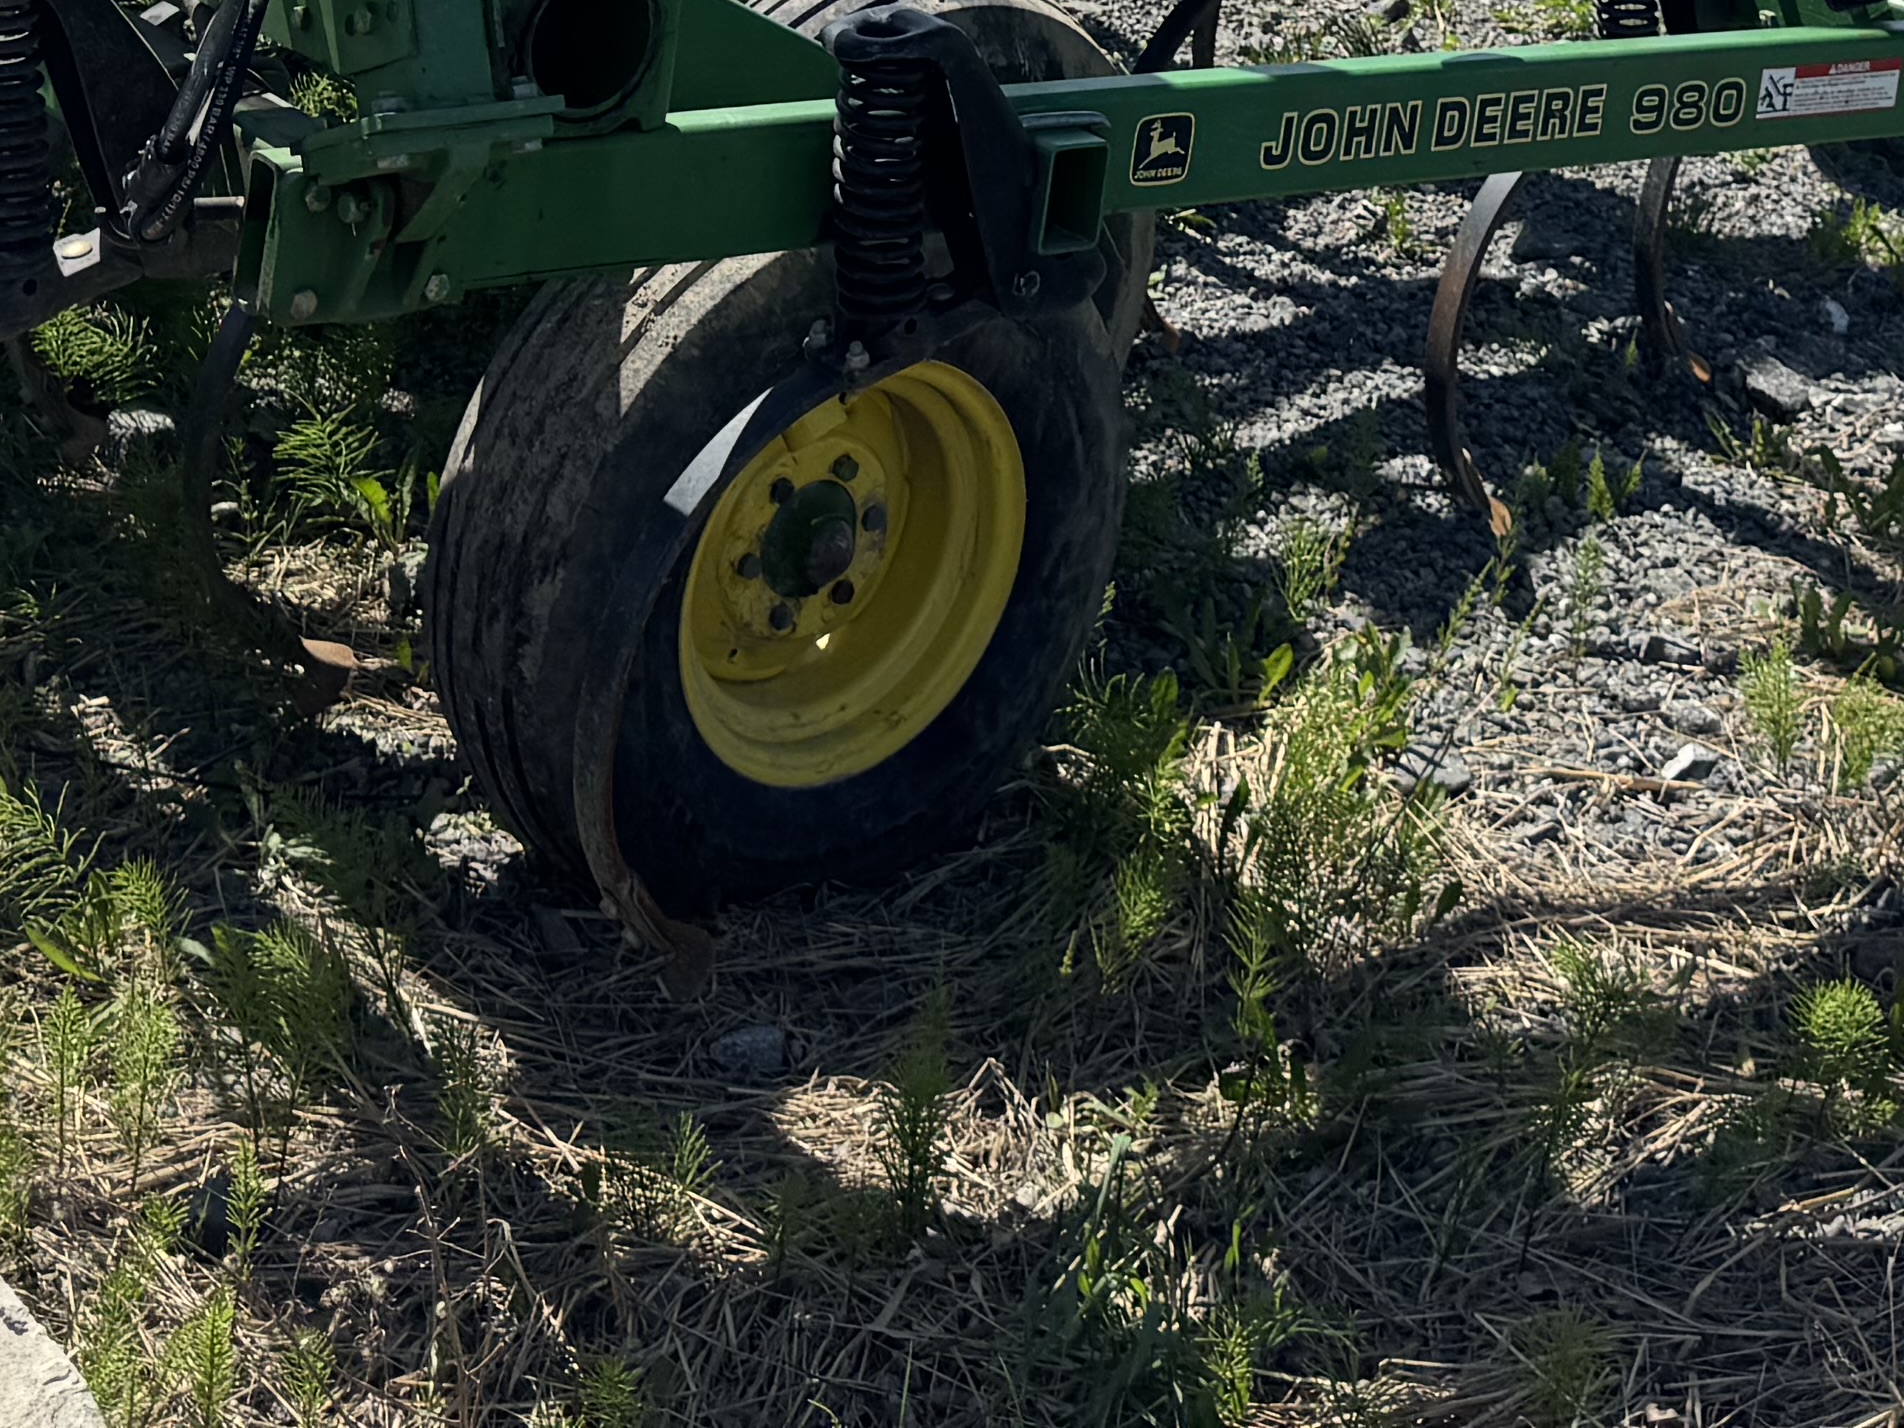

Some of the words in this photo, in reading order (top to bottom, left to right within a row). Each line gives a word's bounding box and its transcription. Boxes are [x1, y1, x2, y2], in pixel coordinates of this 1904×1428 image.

[1835, 61, 1871, 74] DANGER
[1260, 100, 1423, 170] JOHN
[1431, 83, 1607, 151] DEERE
[1630, 77, 1746, 135] 980
[1134, 169, 1156, 179] JOHN
[1158, 166, 1182, 177] DEERE
